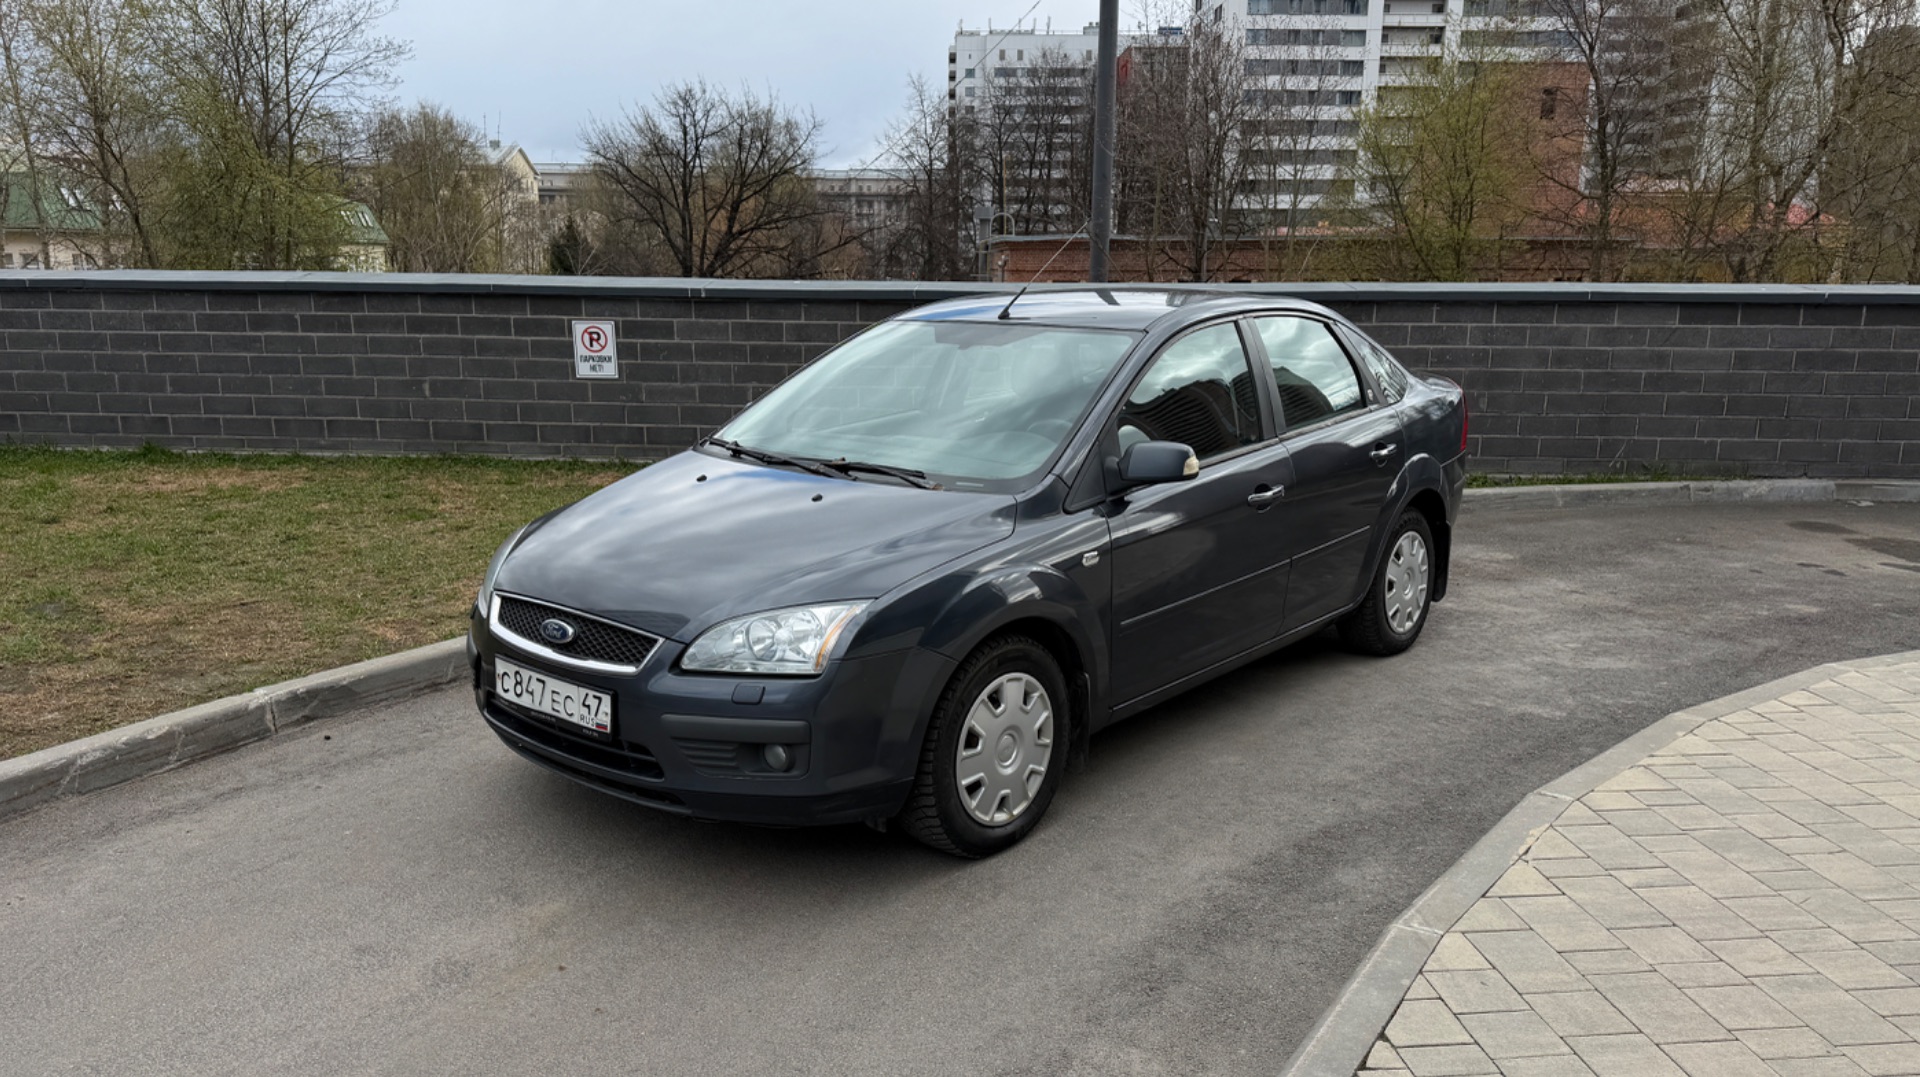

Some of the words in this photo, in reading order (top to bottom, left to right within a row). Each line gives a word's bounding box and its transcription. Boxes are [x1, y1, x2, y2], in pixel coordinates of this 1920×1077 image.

[580, 355, 612, 363] ПАРКОВКИ
[582, 692, 603, 717] 47
[580, 714, 595, 728] RUS
